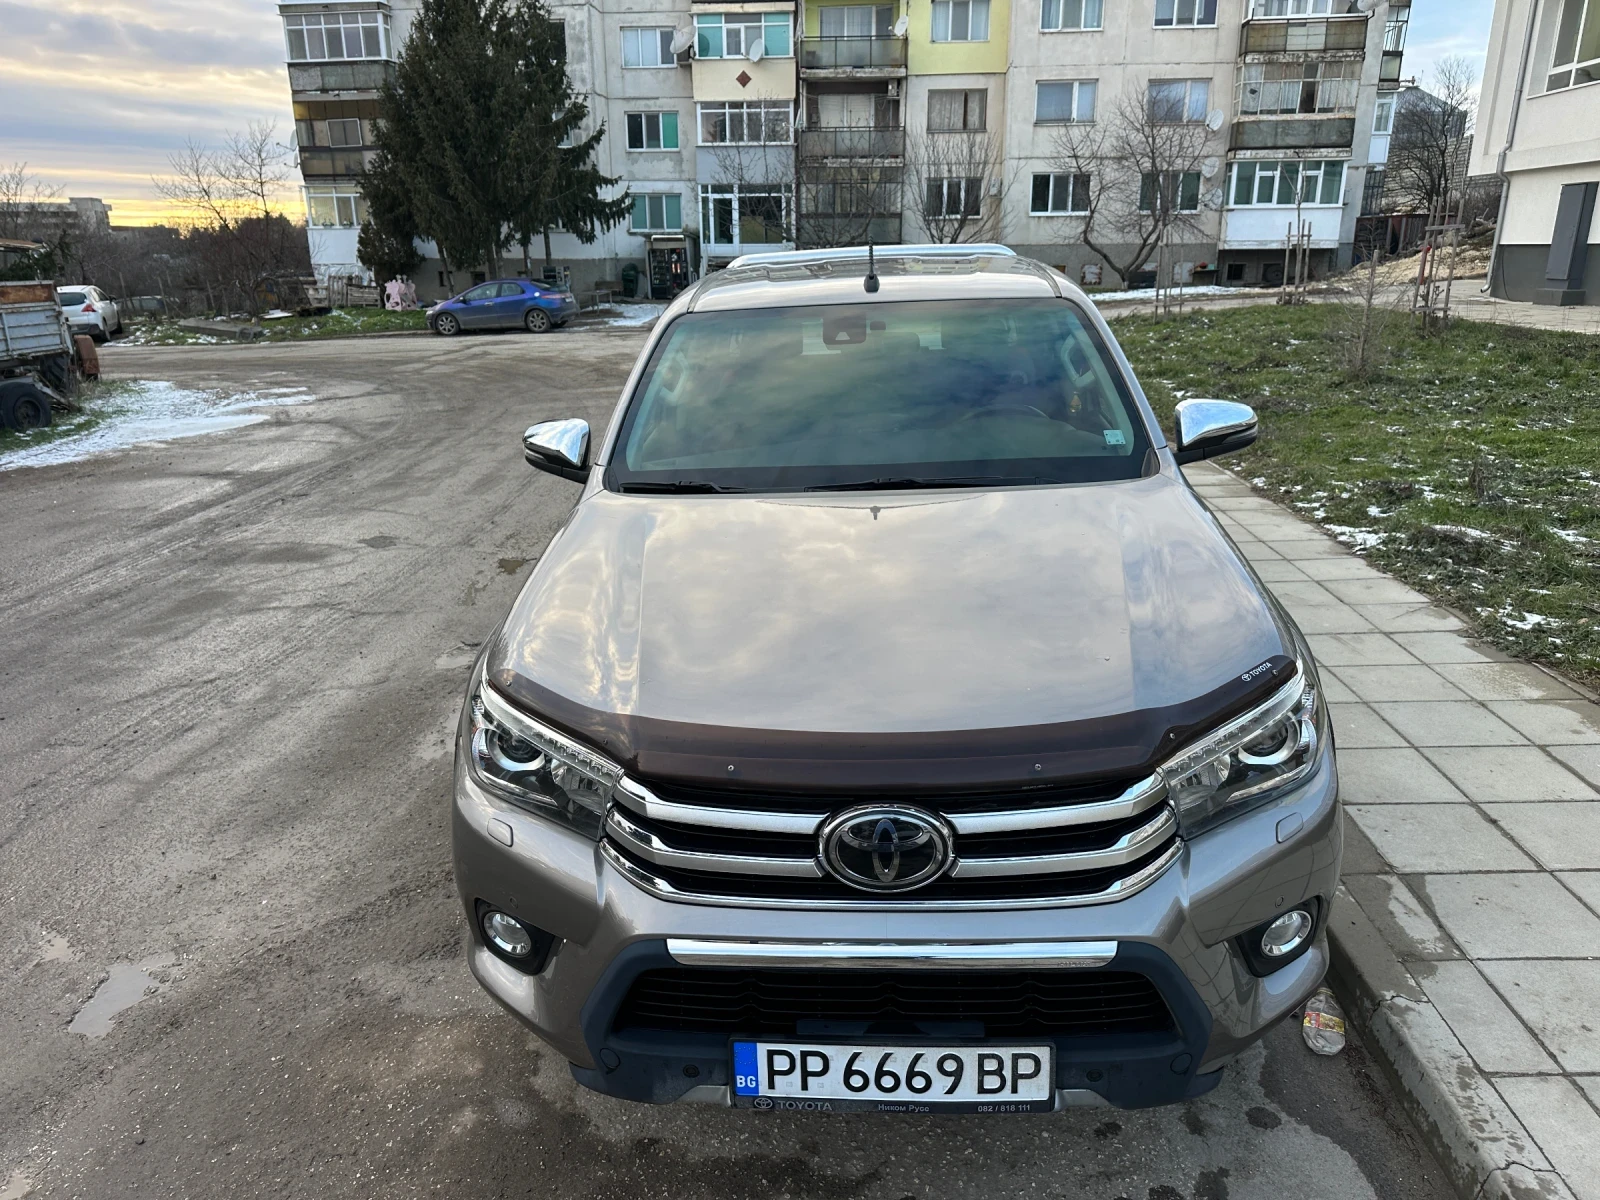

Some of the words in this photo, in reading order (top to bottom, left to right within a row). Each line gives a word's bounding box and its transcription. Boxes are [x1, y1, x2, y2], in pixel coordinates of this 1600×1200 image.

[1249, 661, 1272, 677] TOYOTA
[766, 1048, 830, 1091] PP
[842, 1051, 964, 1095] 6669
[977, 1052, 1041, 1095] BP
[736, 1075, 756, 1088] BG
[777, 1100, 833, 1111] TOYOTA
[878, 1103, 906, 1111] Ником
[1000, 1104, 1016, 1112] 818
